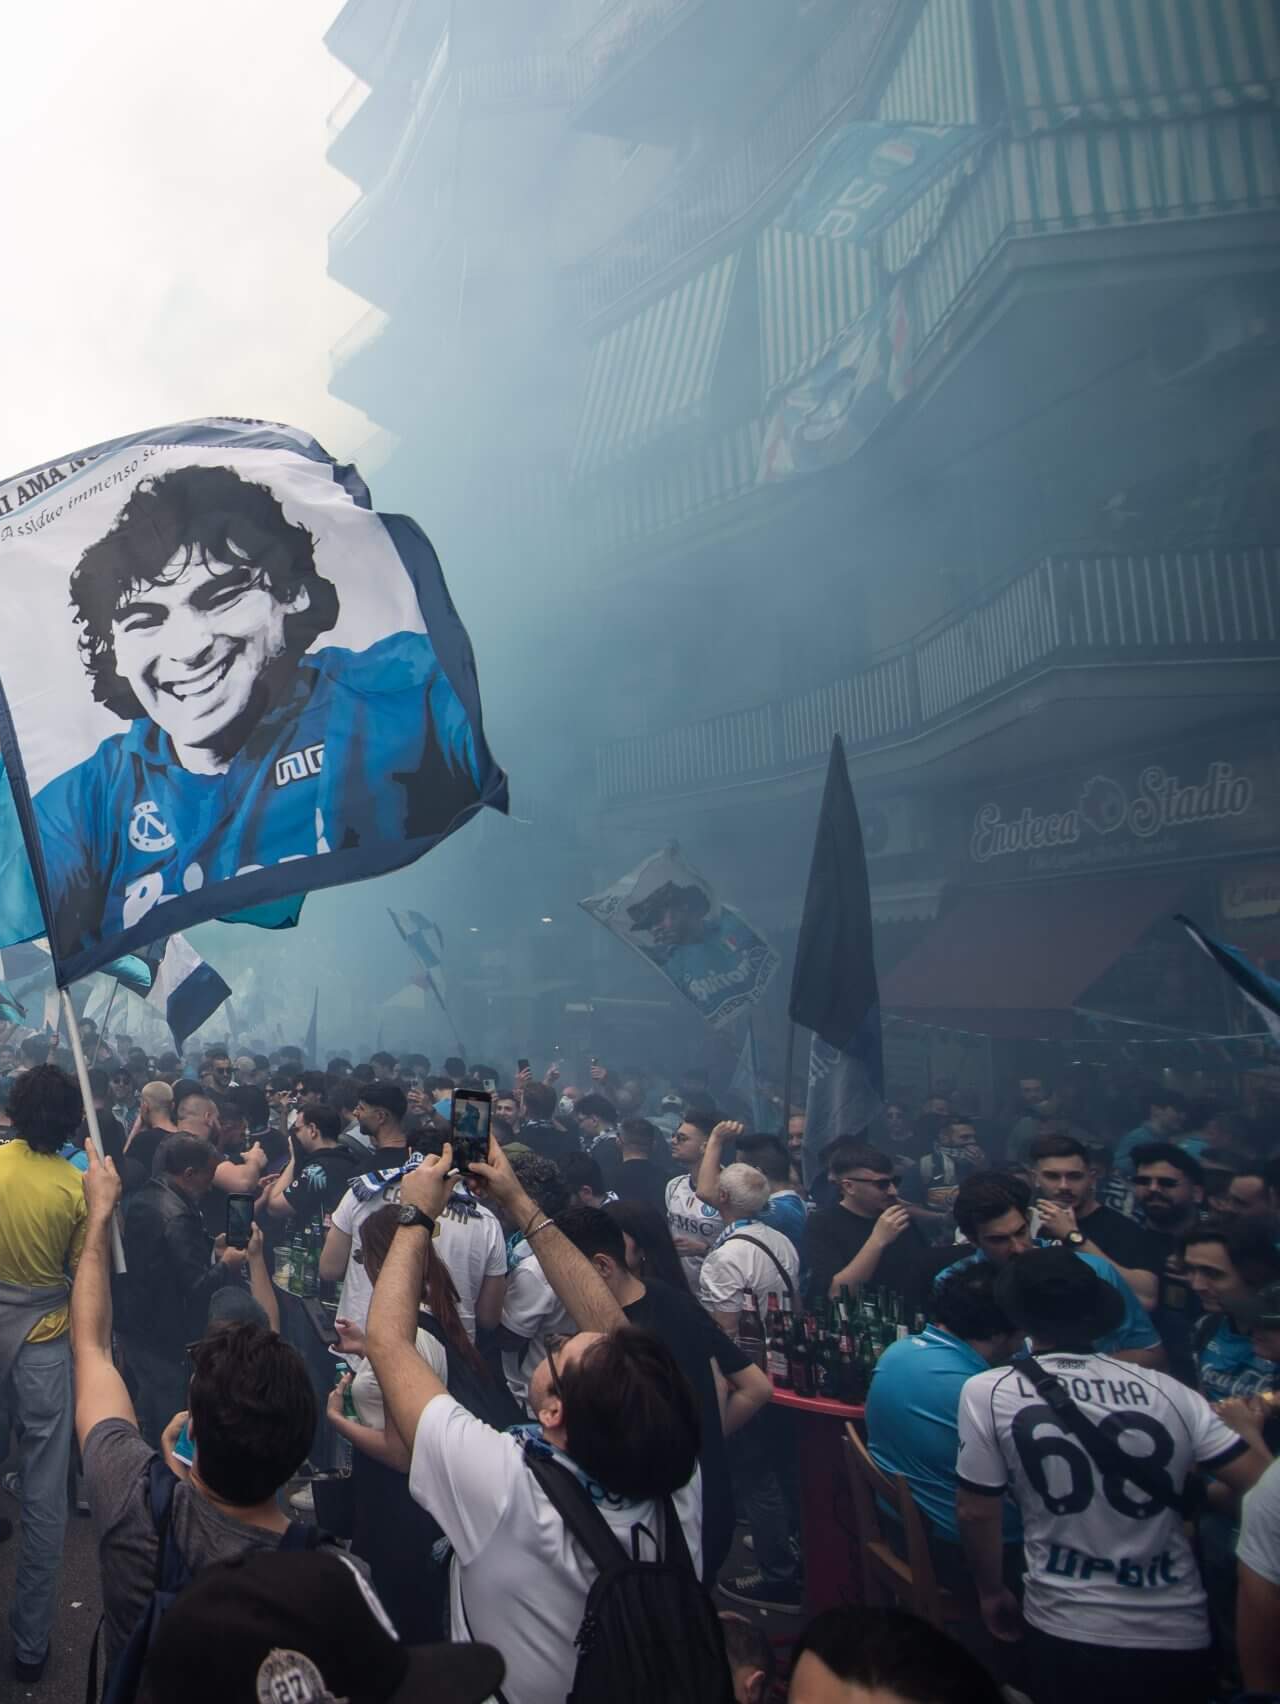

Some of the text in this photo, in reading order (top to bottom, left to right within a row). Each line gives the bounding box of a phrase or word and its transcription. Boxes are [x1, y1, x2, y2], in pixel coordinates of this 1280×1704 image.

[17, 465, 66, 506] AMA
[66, 458, 138, 511] immenso
[971, 803, 1081, 862] Enoteca
[1130, 762, 1253, 837] Stadio
[1017, 1377, 1150, 1406] LOTKA
[1011, 1404, 1176, 1520] 68
